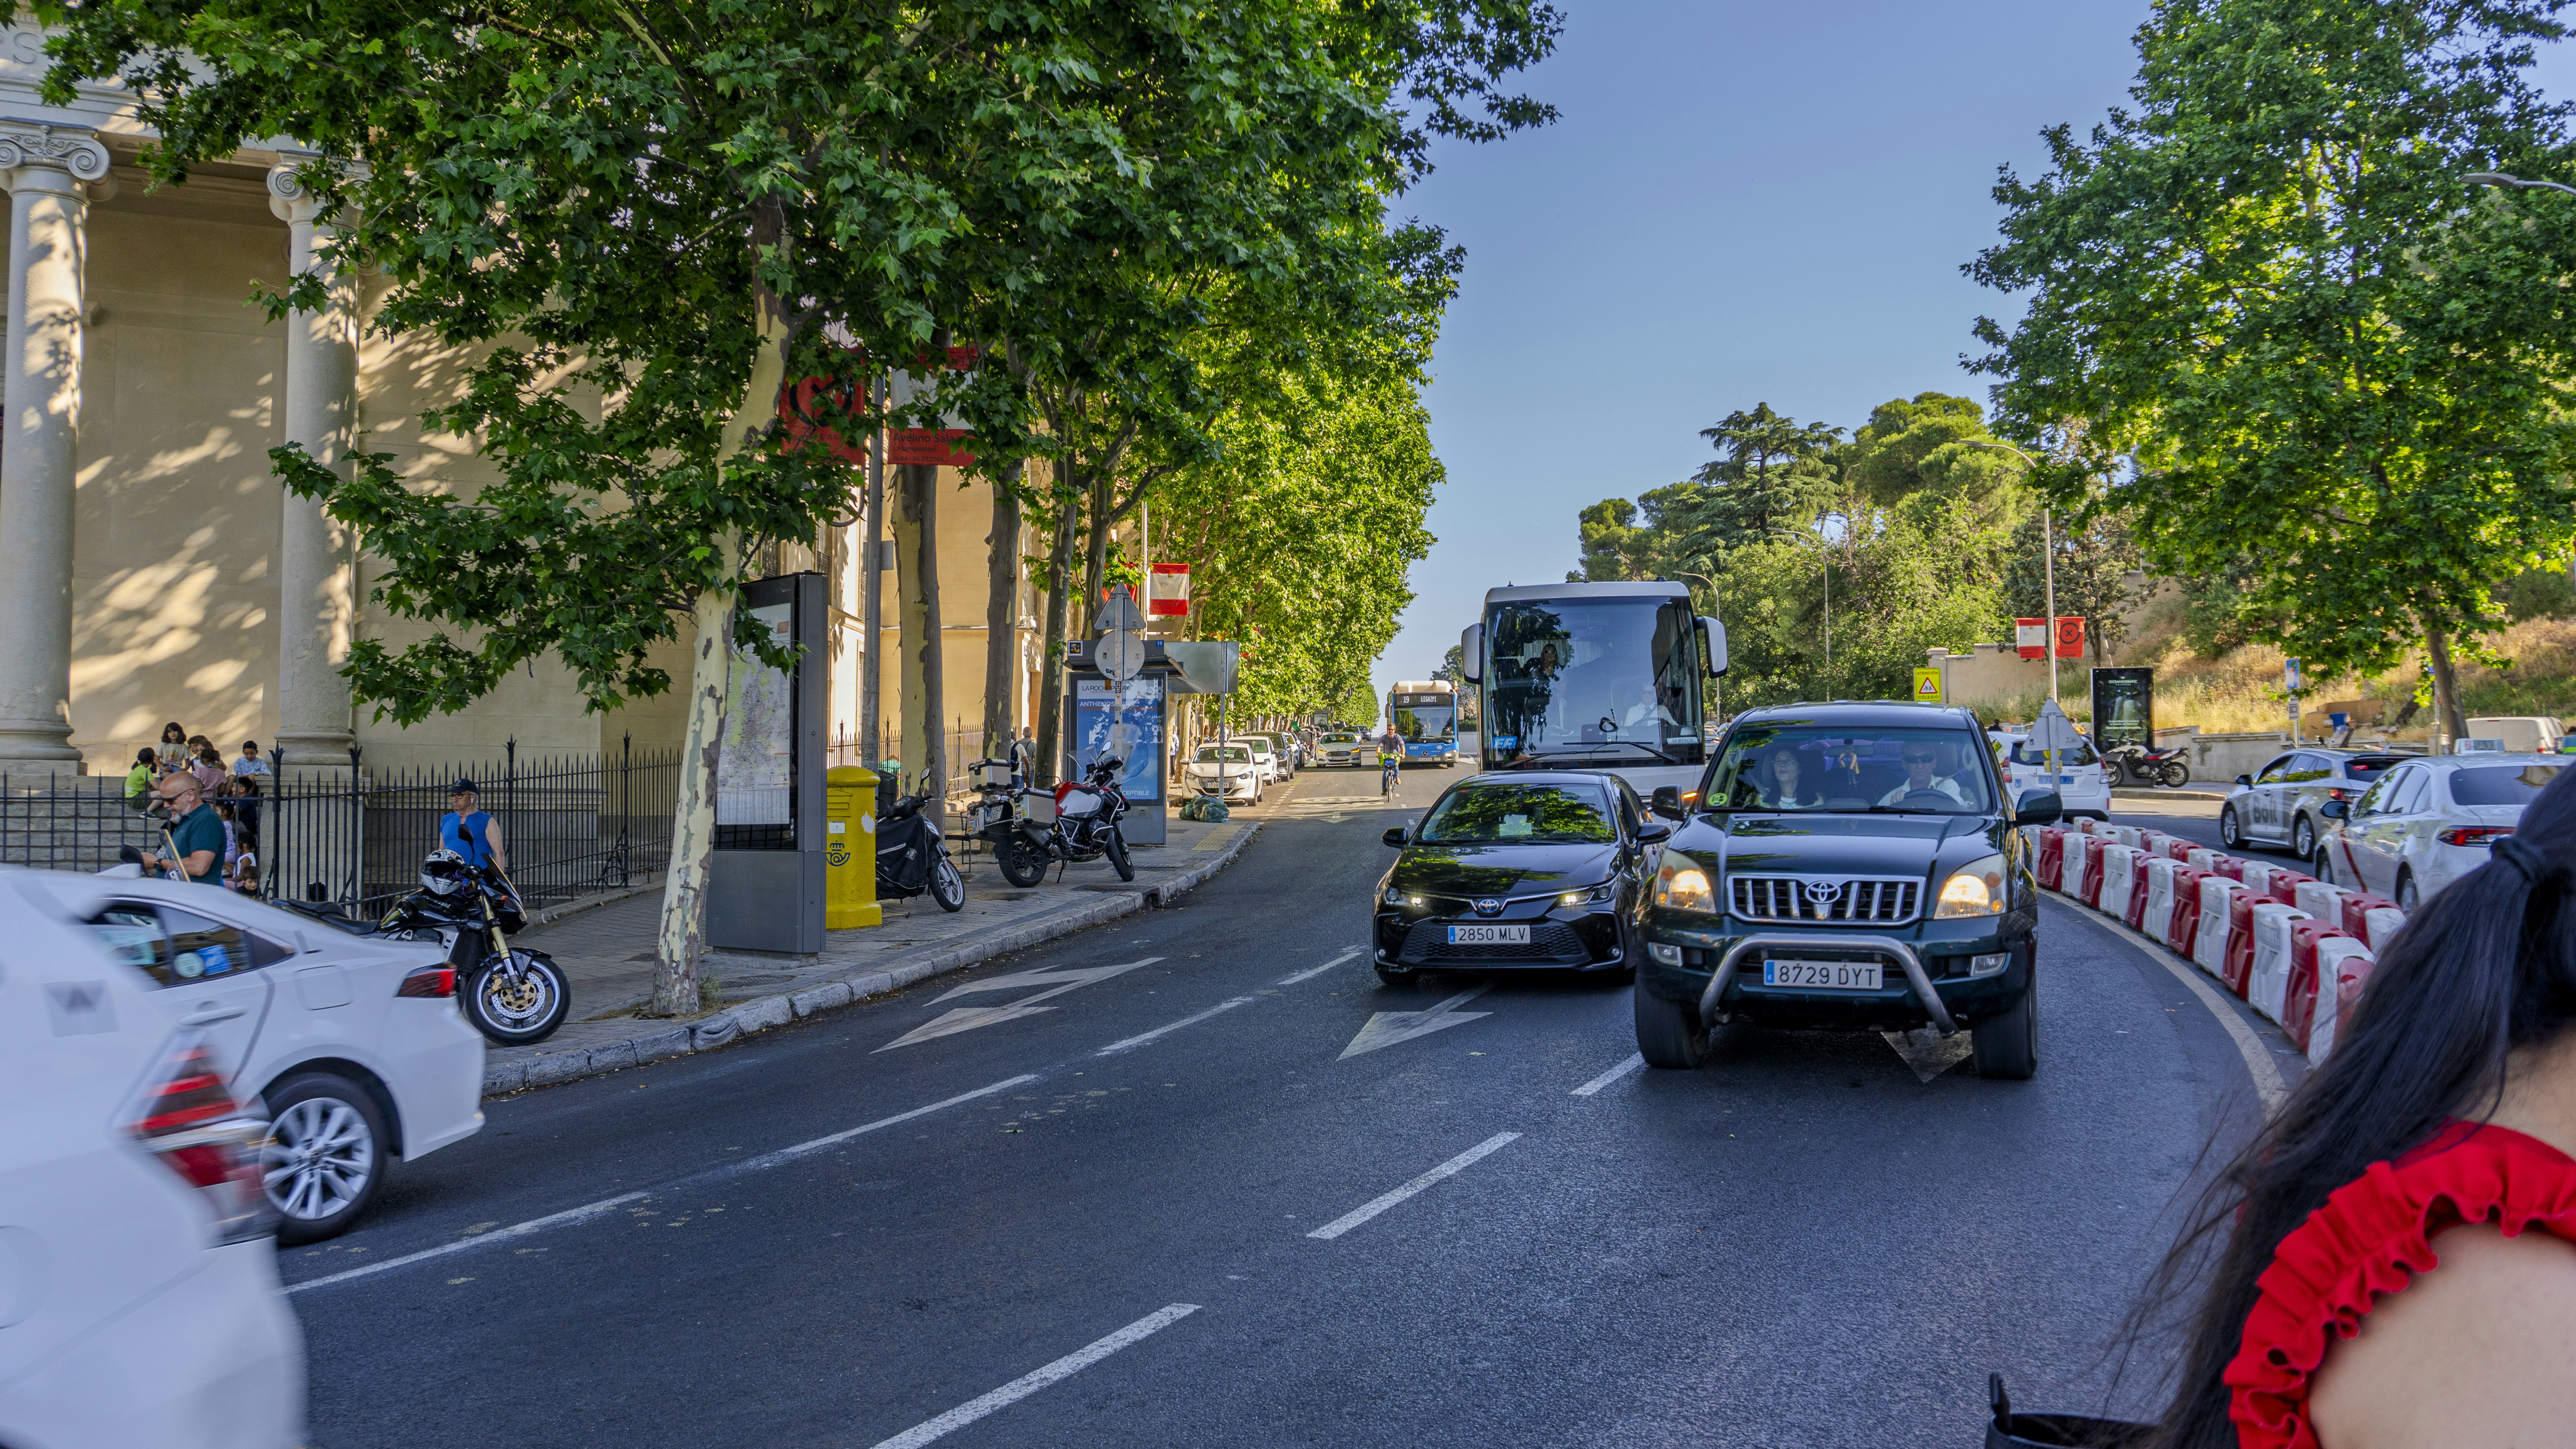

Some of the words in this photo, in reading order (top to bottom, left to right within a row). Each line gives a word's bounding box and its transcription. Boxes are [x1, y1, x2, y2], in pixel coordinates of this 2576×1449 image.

[893, 433, 930, 442] Avelino
[991, 806, 1002, 815] 2345
[2253, 795, 2278, 823] Bolt
[1459, 928, 1494, 941] 2850
[1499, 927, 1525, 940] MLV
[1779, 965, 1830, 984] 8729
[1838, 967, 1876, 986] DYT
